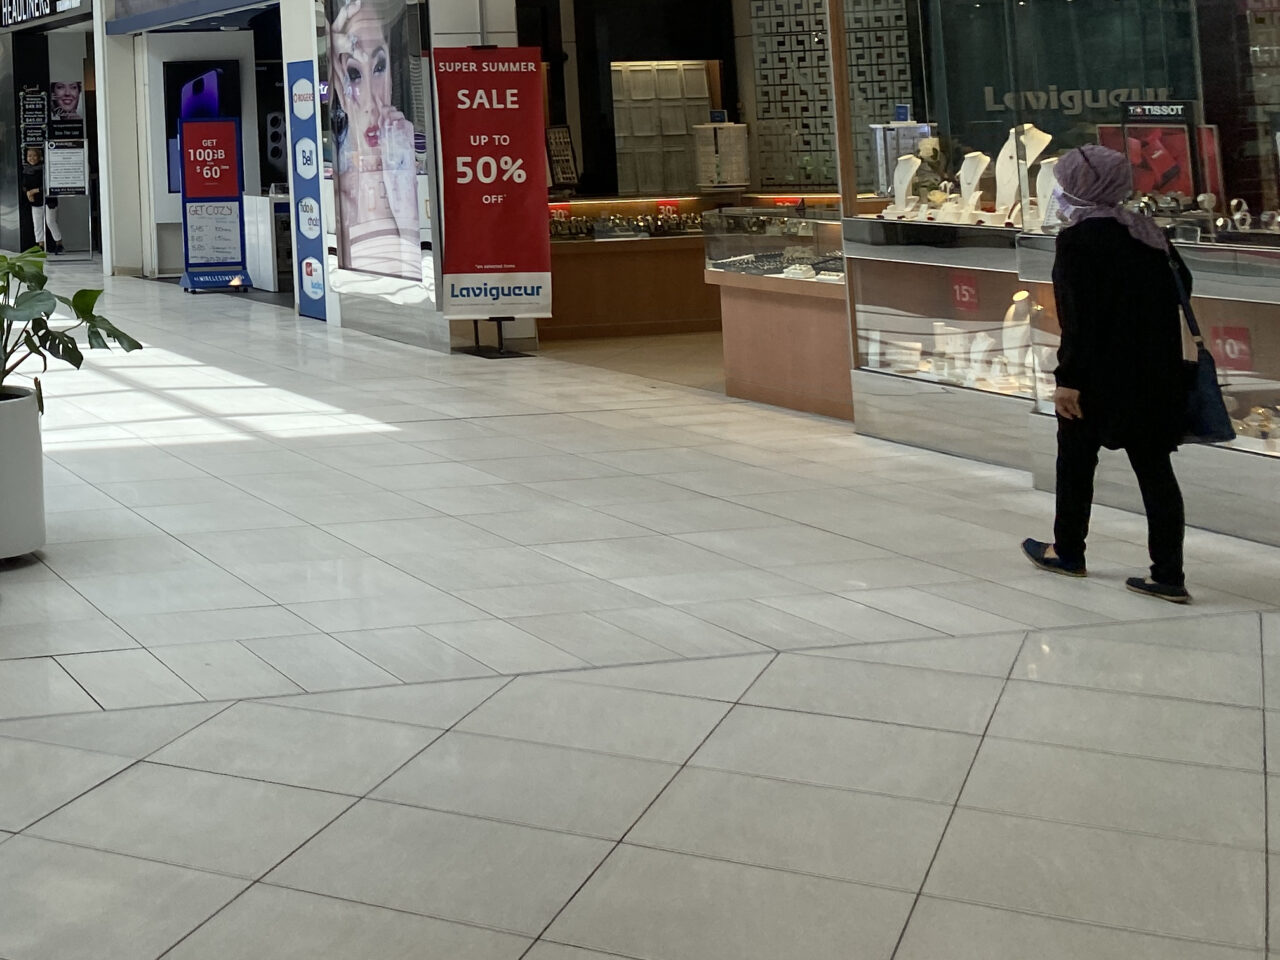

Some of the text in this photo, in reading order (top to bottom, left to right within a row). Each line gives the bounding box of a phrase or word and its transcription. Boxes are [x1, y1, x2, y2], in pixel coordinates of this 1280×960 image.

[438, 62, 537, 73] SUPER SUMMER
[456, 89, 520, 109] SALE
[1145, 105, 1184, 116] TISSOT
[201, 139, 217, 147] GET
[470, 135, 510, 146] UP TO
[302, 149, 313, 166] Bell
[456, 155, 527, 184] 50%
[189, 204, 205, 216] GET
[450, 283, 543, 301] Lavigueur
